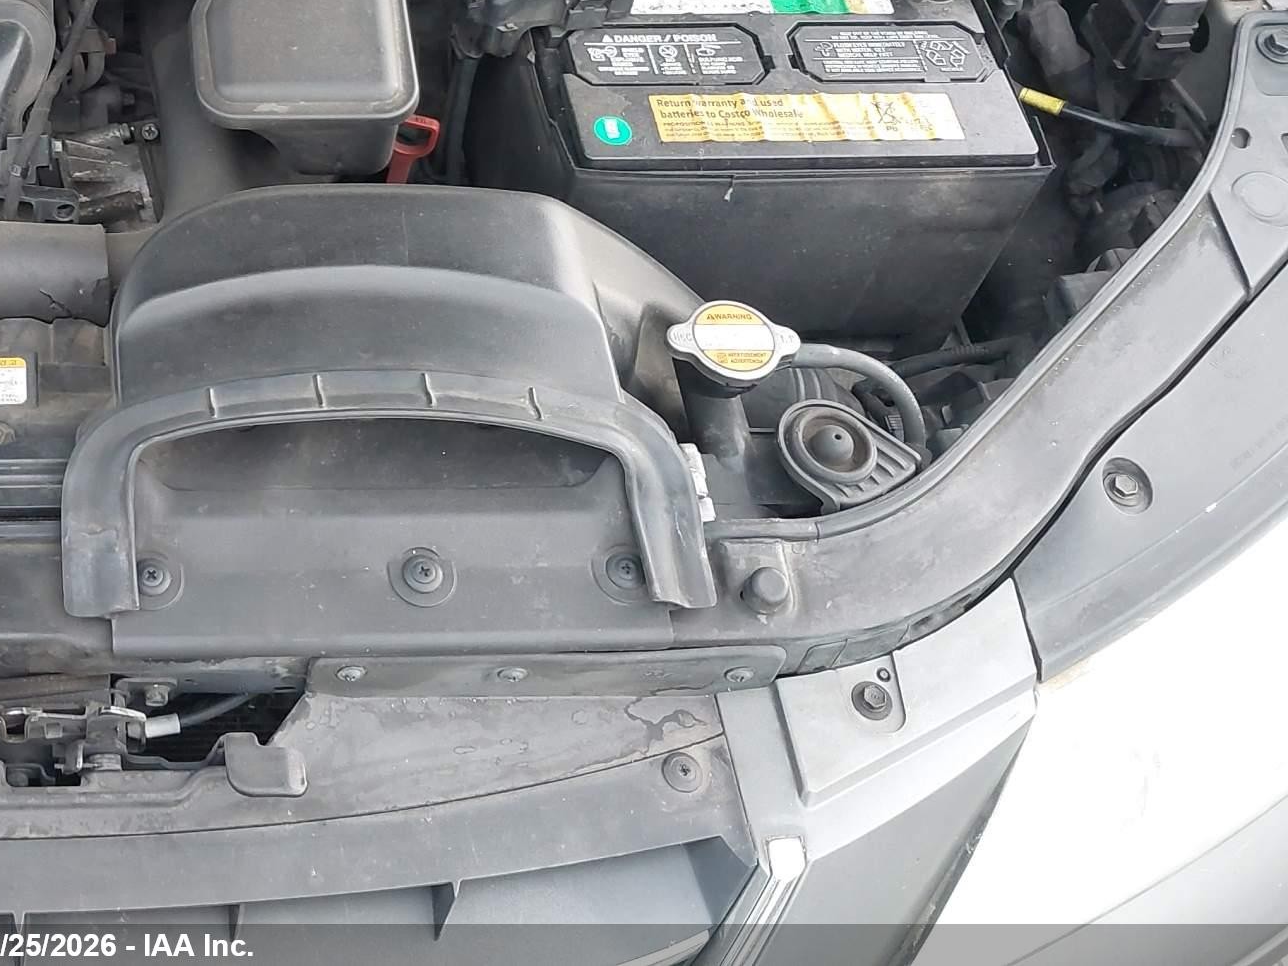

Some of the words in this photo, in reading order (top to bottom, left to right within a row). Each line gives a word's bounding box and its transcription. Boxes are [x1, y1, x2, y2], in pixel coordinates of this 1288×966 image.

[614, 34, 662, 43] DANGER
[673, 34, 717, 42] POISON
[656, 99, 691, 107] Return
[761, 98, 783, 107] used
[661, 109, 705, 118] batteries
[706, 110, 716, 118] to
[718, 109, 751, 119] Costco
[752, 108, 804, 118] Wholesale
